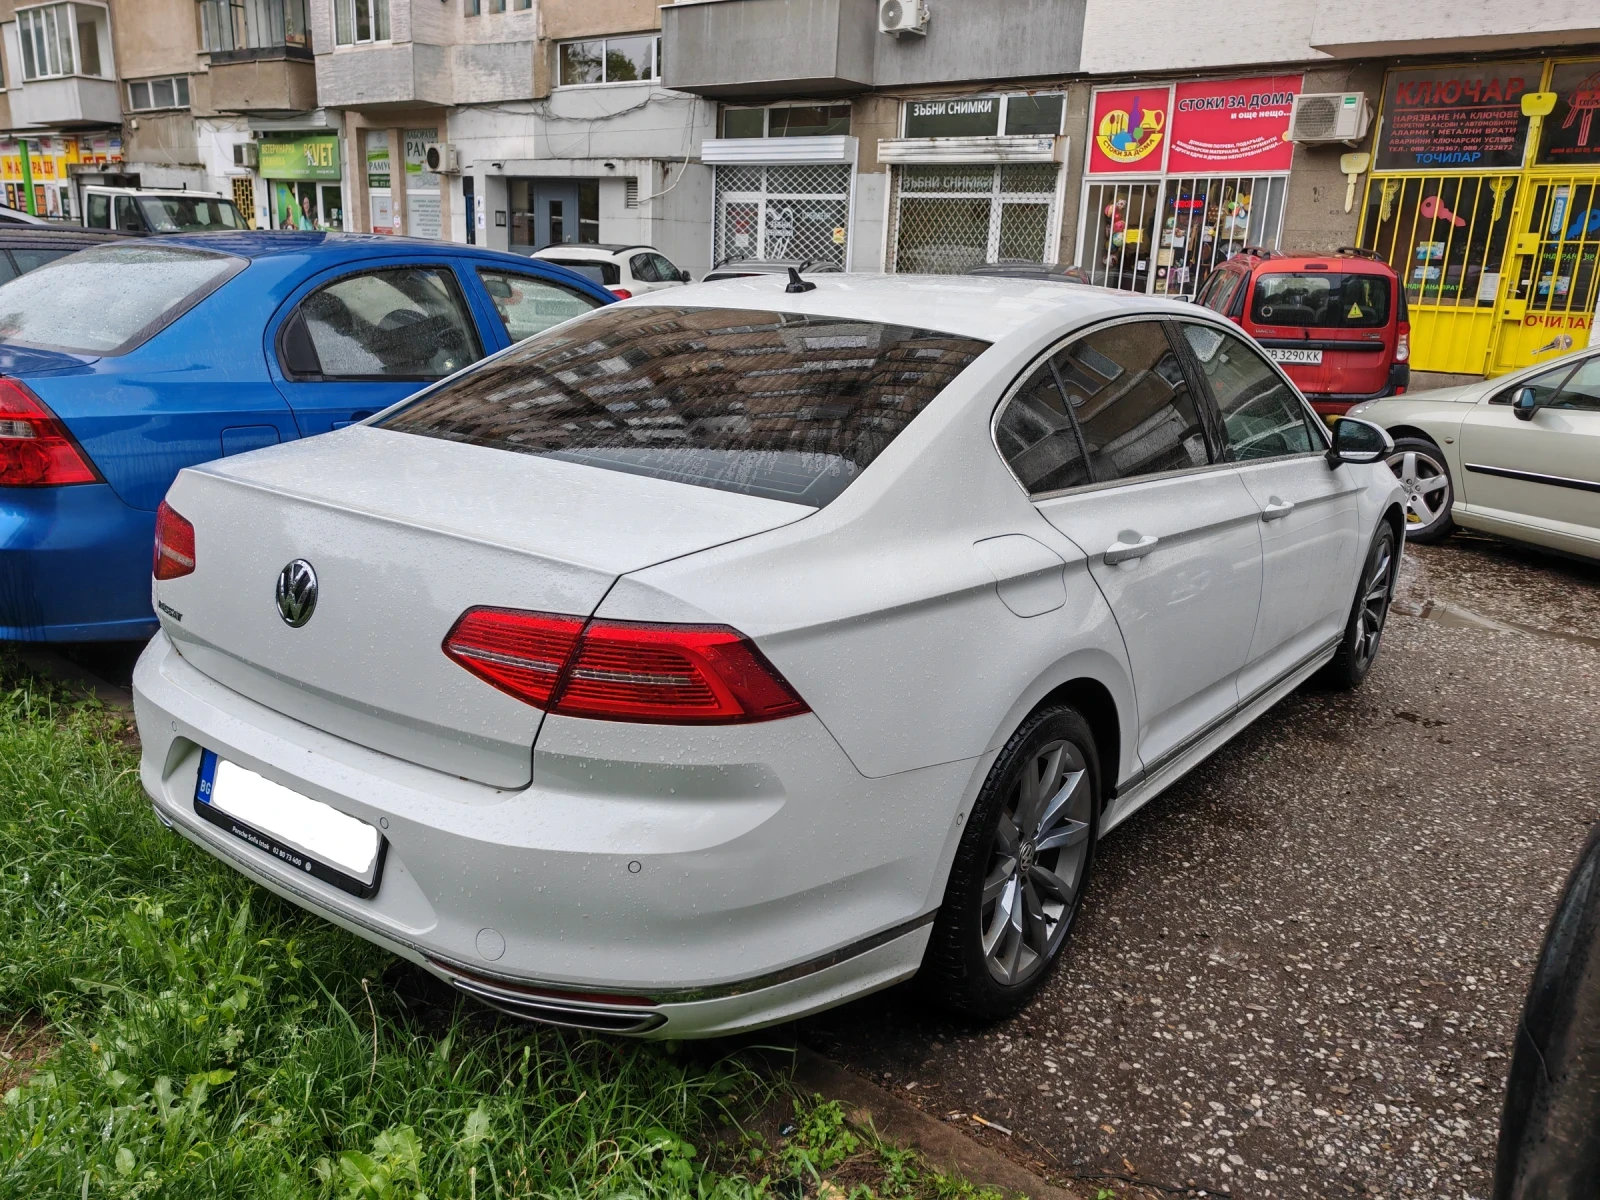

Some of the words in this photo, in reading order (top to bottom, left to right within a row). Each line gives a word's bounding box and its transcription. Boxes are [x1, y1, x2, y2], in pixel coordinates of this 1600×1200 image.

[1396, 77, 1525, 104] КЛЮЧАР
[913, 102, 946, 116] ЗЪБНИ
[948, 100, 992, 114] СНИМКИ
[1178, 96, 1225, 112] СТОКИ
[1227, 94, 1246, 108] ЗА
[1247, 91, 1294, 110] ДОМА
[1238, 110, 1257, 120] още
[1393, 113, 1450, 122] НАРЯЗВАНЕ
[1470, 111, 1519, 119] КЛЮЧОВЕ
[1103, 140, 1122, 156] СТОКИ
[1134, 139, 1155, 156] ДОМА
[1389, 137, 1430, 145] АВАРИЙНИ
[1415, 152, 1481, 163] ТОЧИЛАР
[902, 175, 940, 188] ЗЪБНИ
[943, 175, 993, 188] СНИМКИ
[1280, 350, 1305, 361] 3290
[200, 779, 211, 795] BG
[232, 826, 248, 839] Porsche
[248, 834, 258, 845] Sofia
[272, 846, 279, 855] 02
[286, 853, 292, 861] 73
